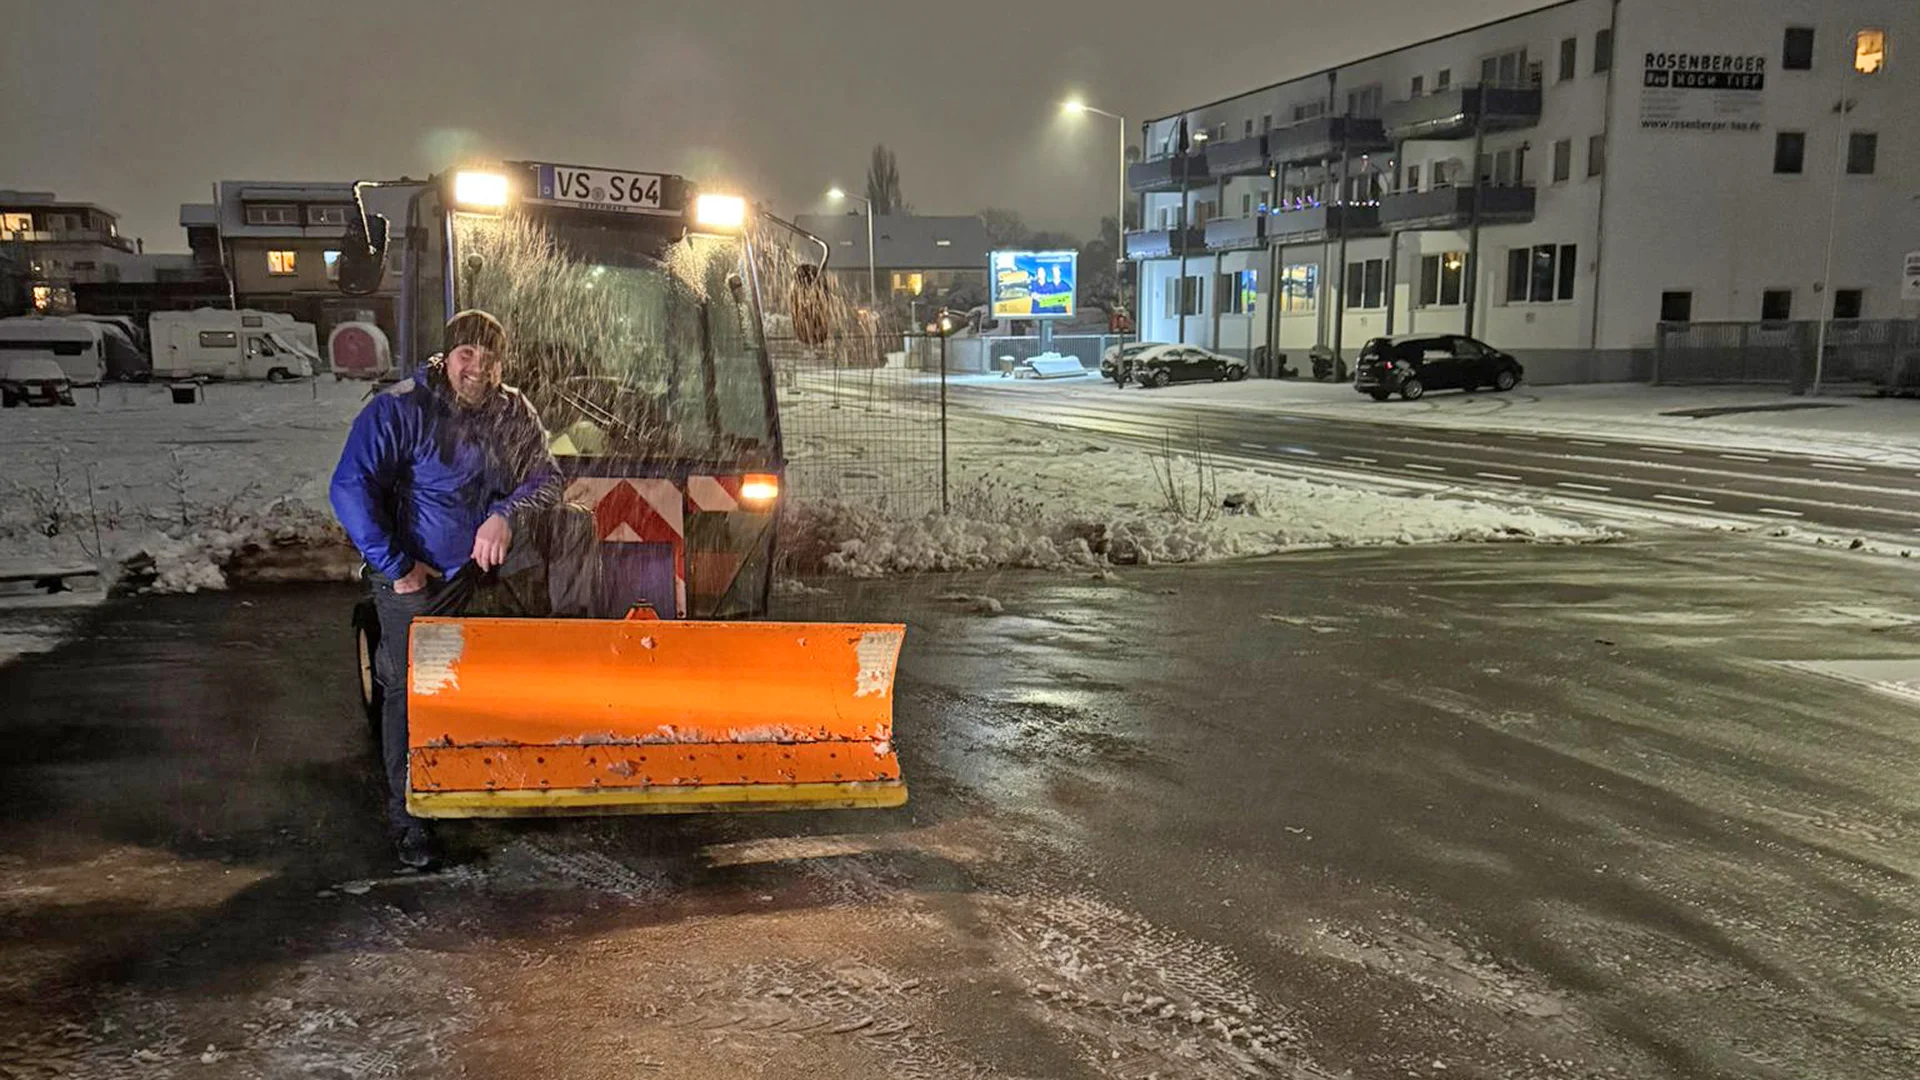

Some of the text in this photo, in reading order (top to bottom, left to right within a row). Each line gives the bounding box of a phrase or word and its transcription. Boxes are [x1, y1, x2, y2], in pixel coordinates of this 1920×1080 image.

[1645, 53, 1767, 72] ROSENBERGER
[1676, 75, 1717, 86] HOCH
[1727, 76, 1760, 88] TIEF
[557, 171, 590, 199] VS
